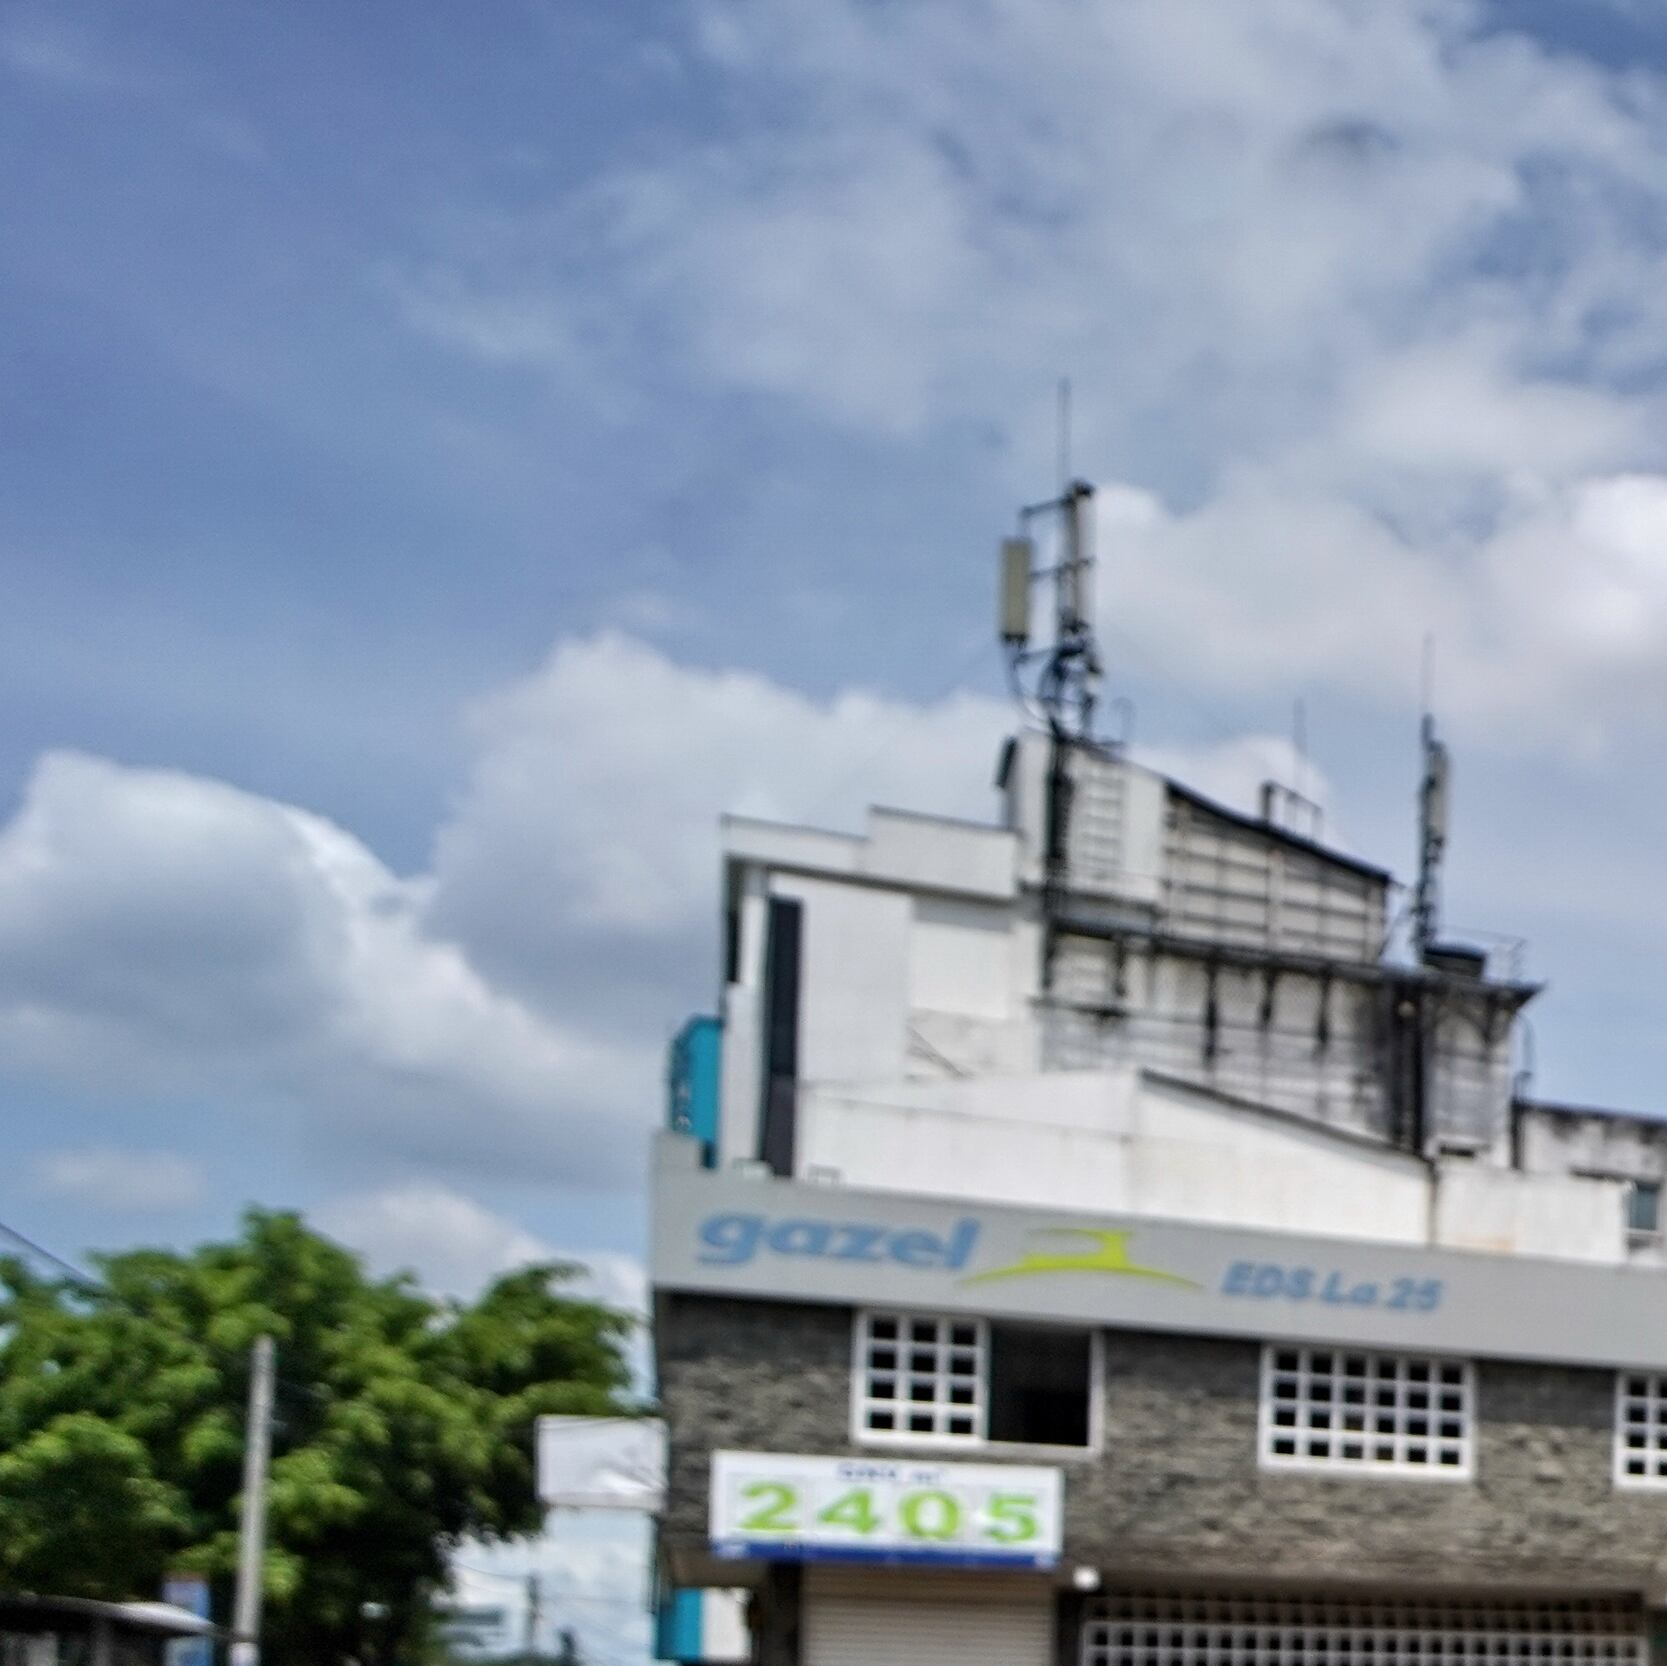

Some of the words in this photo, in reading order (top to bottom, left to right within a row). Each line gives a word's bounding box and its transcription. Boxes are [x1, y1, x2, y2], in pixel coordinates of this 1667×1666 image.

[696, 1211, 981, 1268] gazel
[1221, 1258, 1314, 1299] EDS
[1321, 1271, 1379, 1304] La
[1387, 1274, 1443, 1311] 25
[739, 1479, 1040, 1542] 2405
